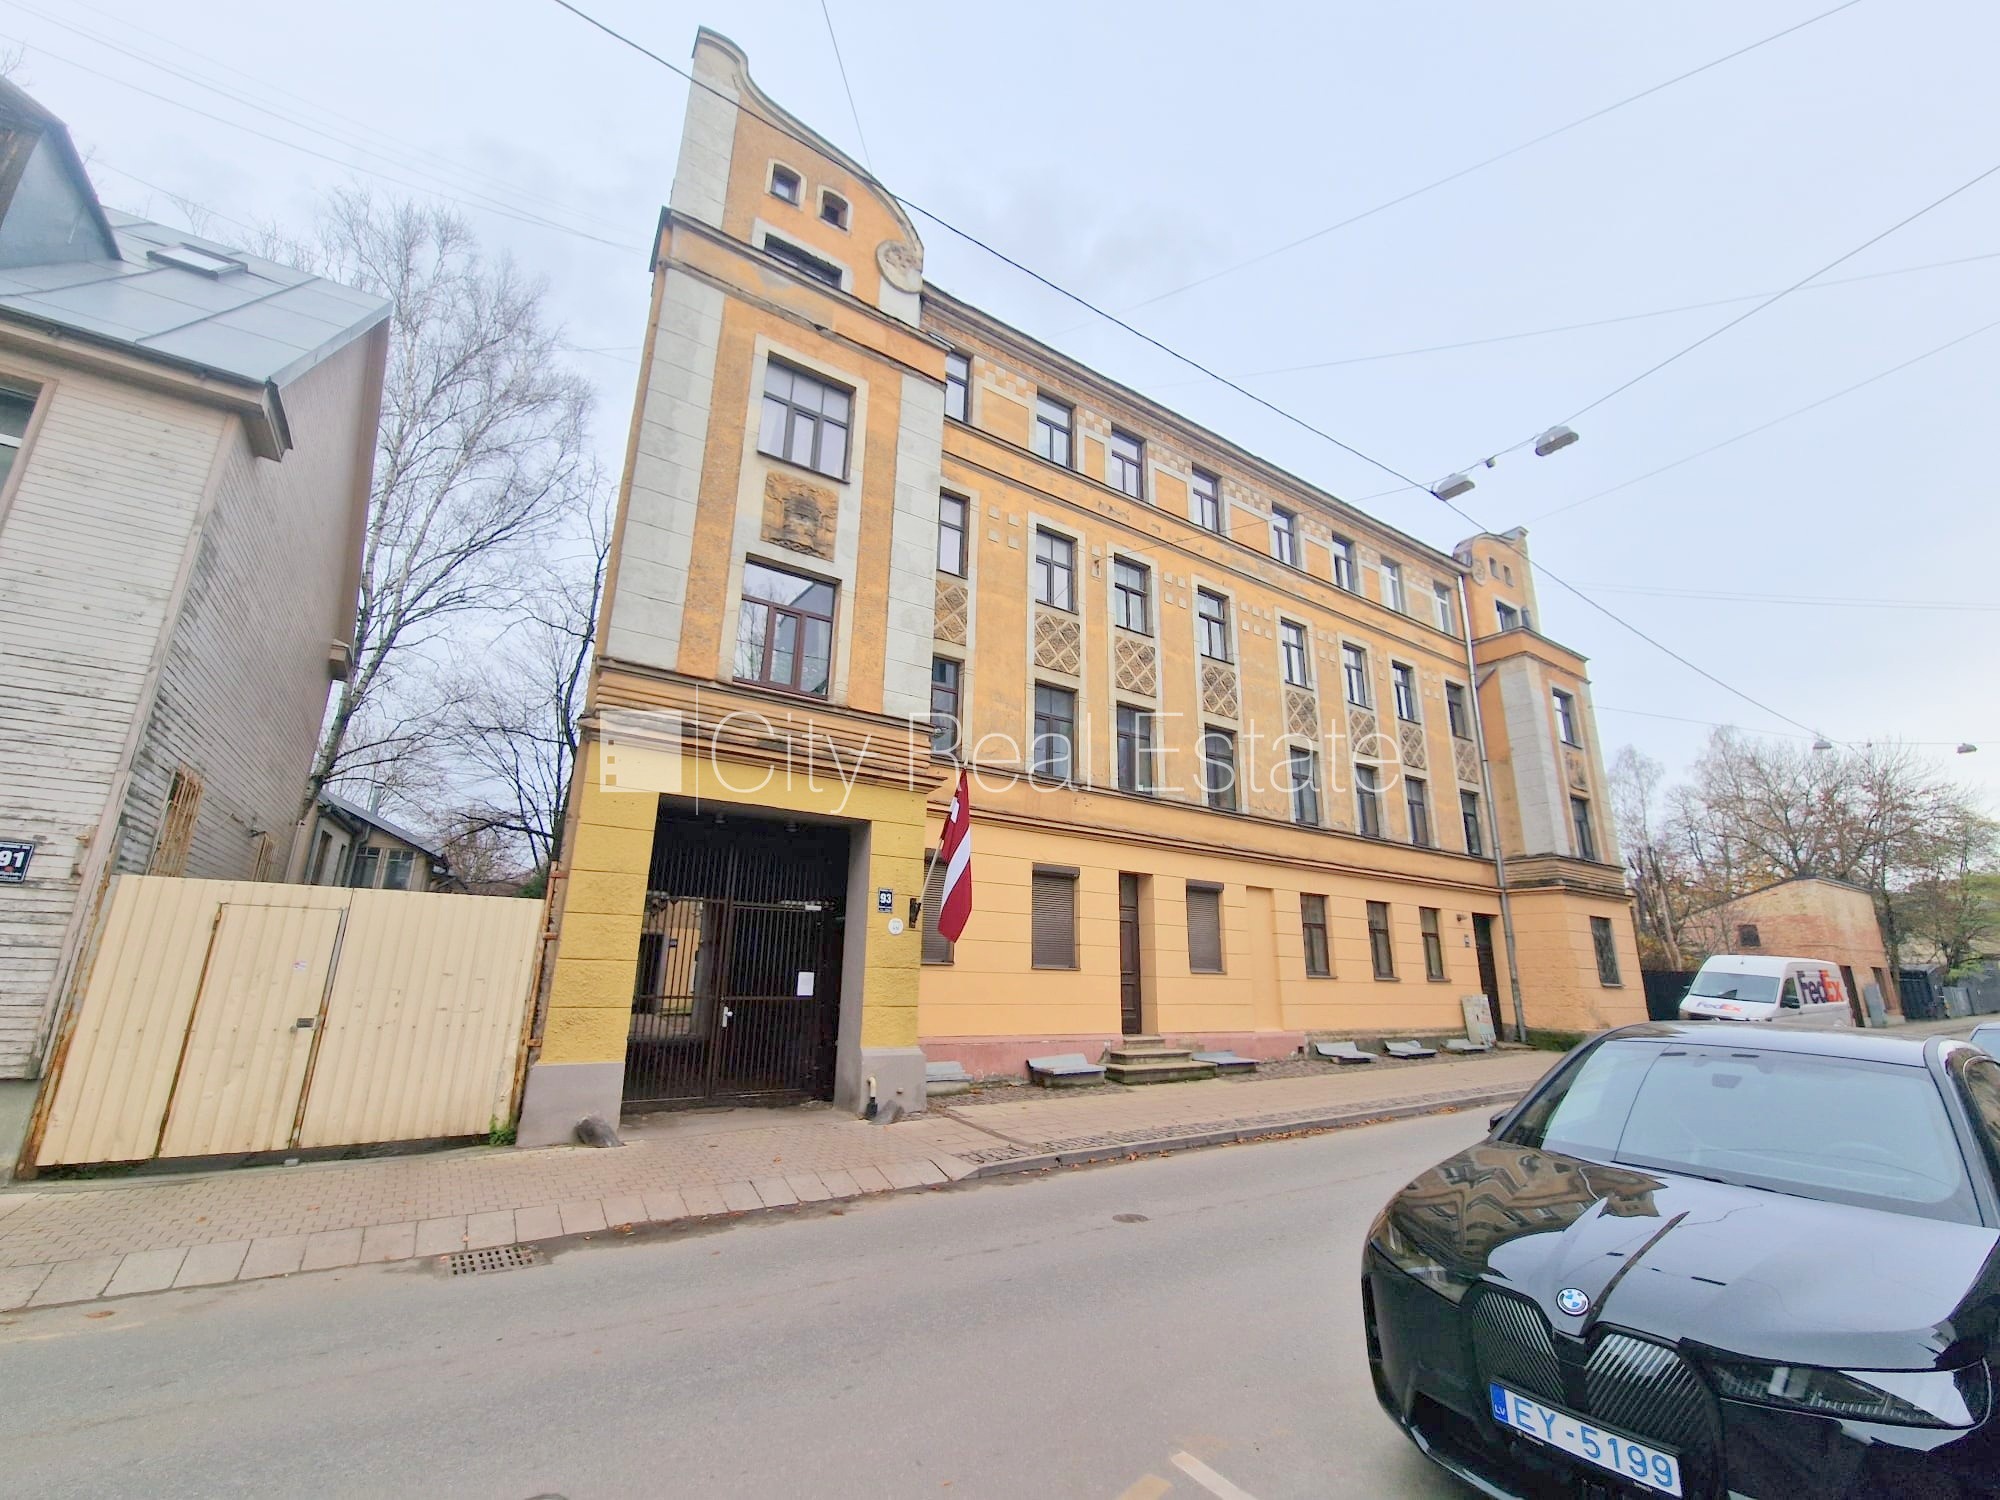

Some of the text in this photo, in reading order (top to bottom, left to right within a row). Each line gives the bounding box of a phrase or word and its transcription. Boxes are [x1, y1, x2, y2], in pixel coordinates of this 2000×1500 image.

[0, 850, 25, 868] 91
[880, 893, 892, 904] 93
[1796, 969, 1844, 1004] FedEx
[1514, 1397, 1673, 1487] EY-5199
